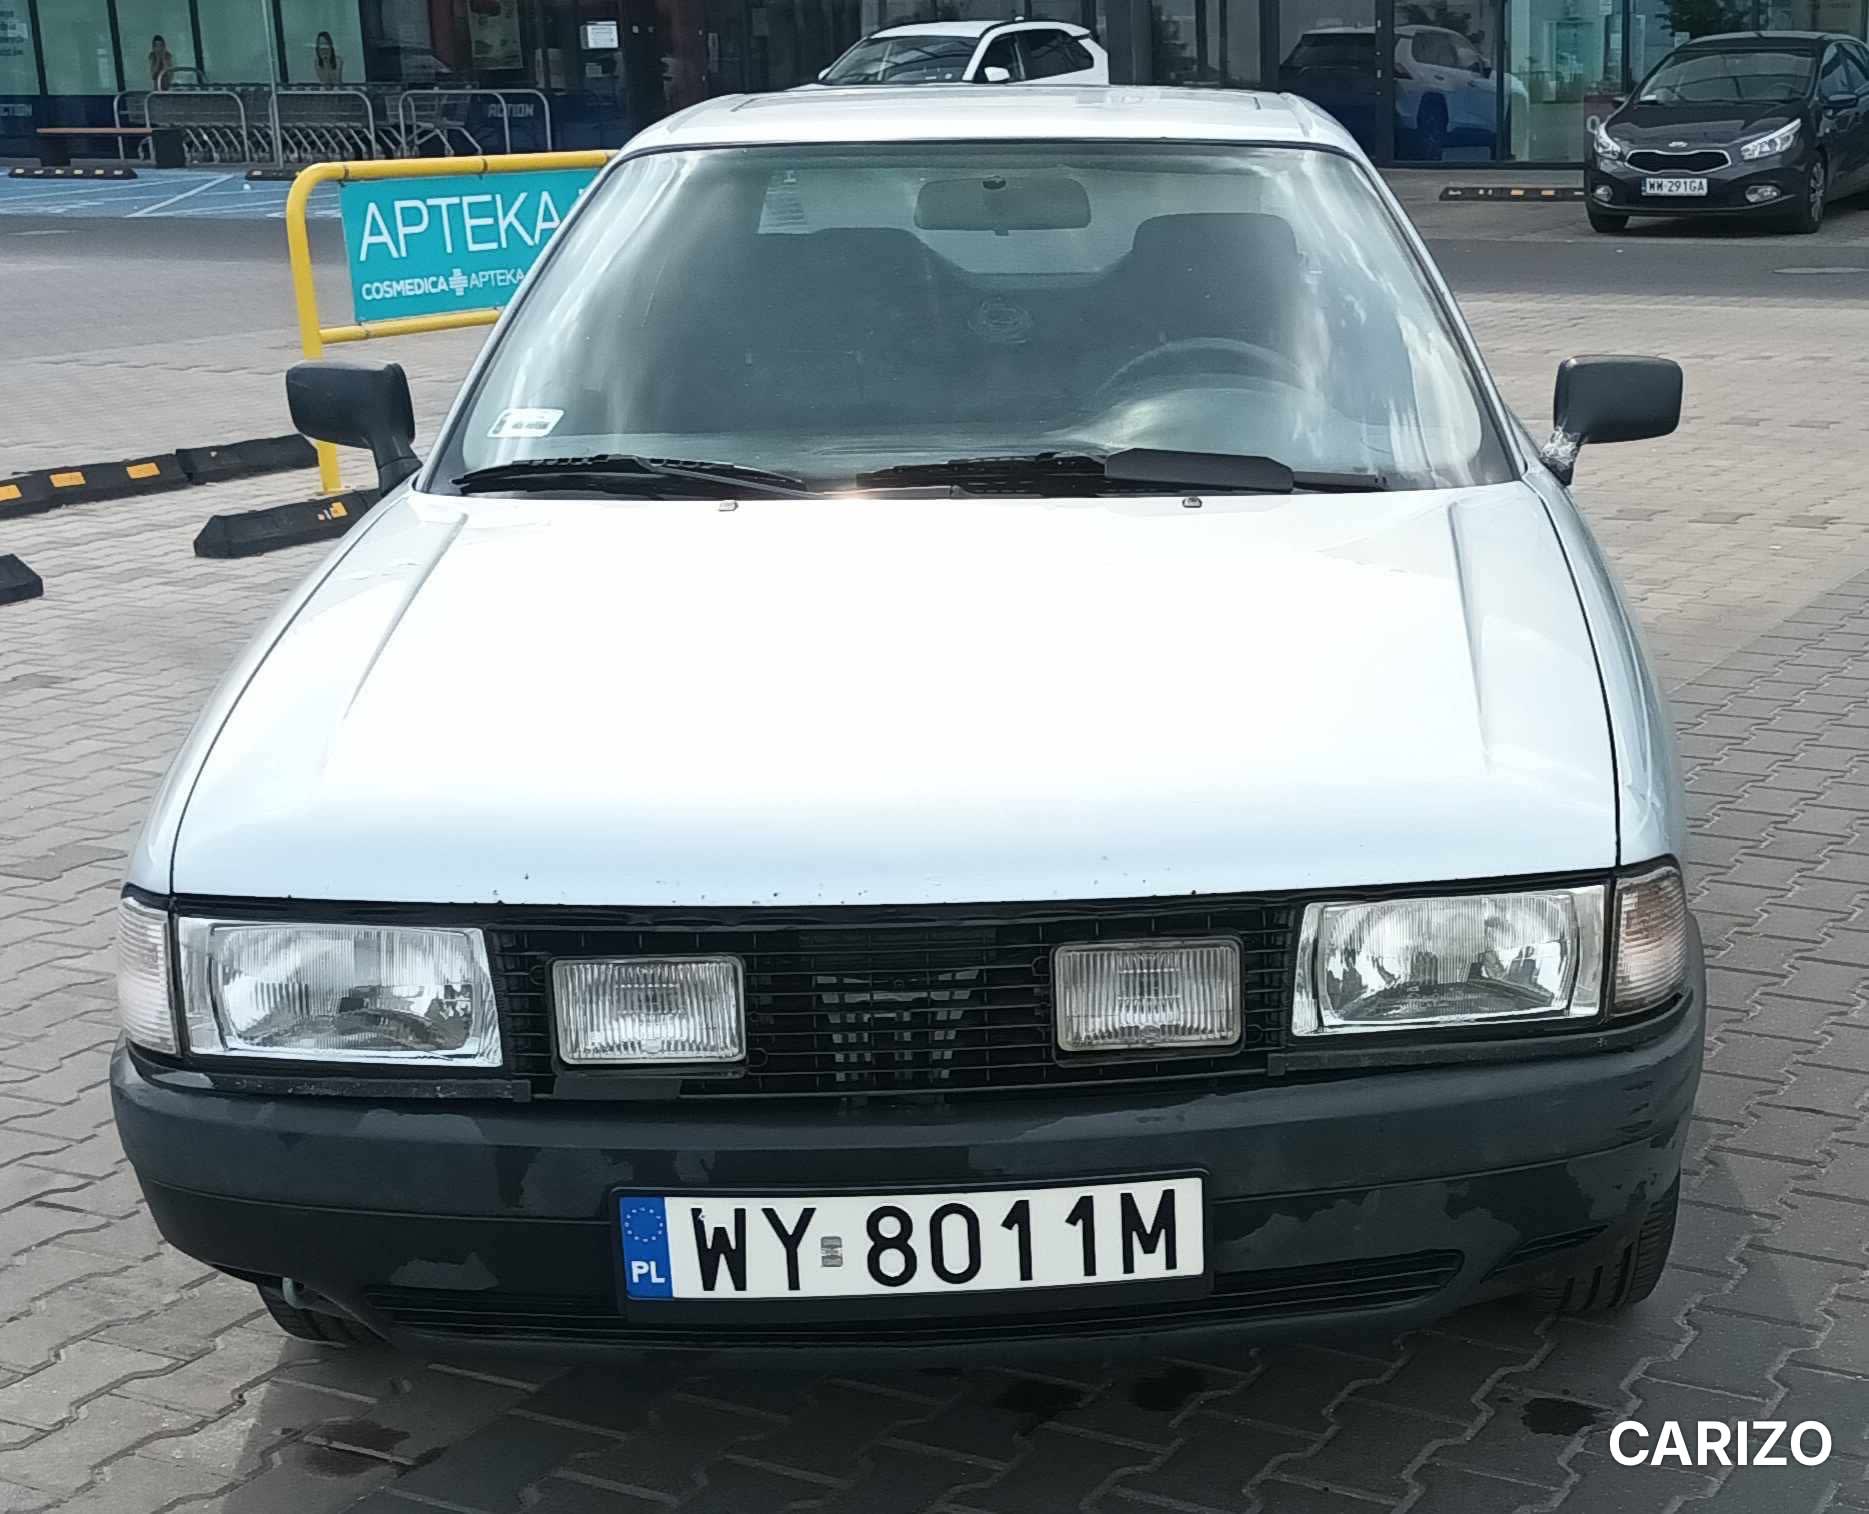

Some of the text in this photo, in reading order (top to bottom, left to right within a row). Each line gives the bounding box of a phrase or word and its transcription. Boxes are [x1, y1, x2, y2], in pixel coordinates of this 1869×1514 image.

[360, 191, 561, 261] APTEKA
[362, 267, 525, 300] COSMEDICA APTEKA
[691, 1188, 1177, 1291] WY 8011M
[631, 1260, 665, 1284] PL
